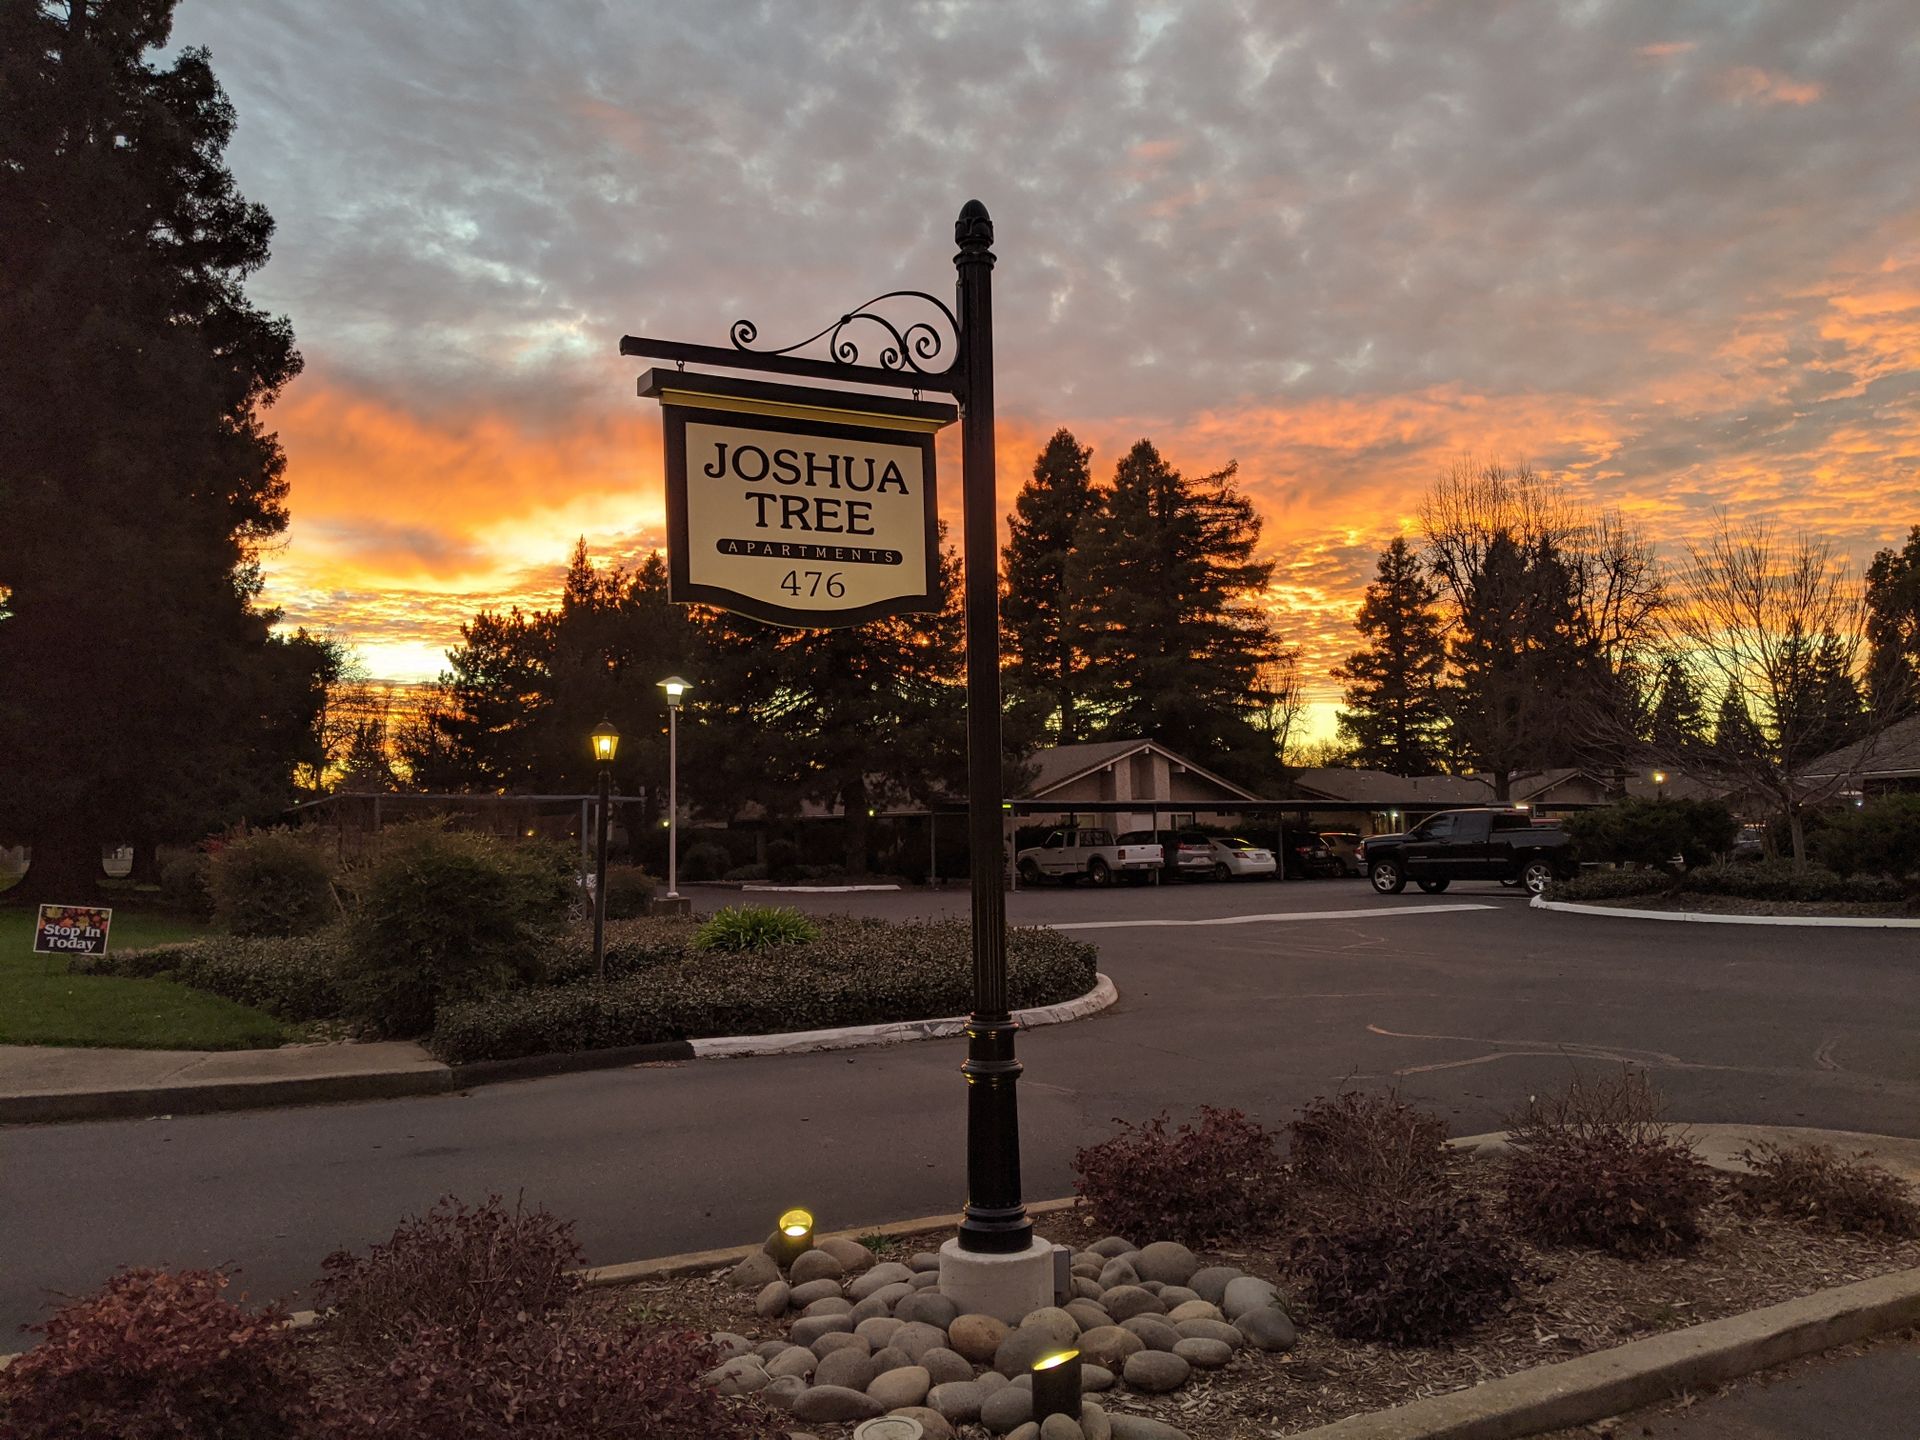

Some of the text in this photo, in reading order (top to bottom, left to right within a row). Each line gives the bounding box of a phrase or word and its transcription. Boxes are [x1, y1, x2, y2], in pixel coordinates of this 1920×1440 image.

[704, 442, 910, 495] JOSHUA
[745, 491, 875, 535] TREE
[727, 541, 893, 563] APARTMENTS
[780, 570, 845, 598] 476
[44, 924, 100, 939] Stop In
[47, 937, 96, 952] Today
